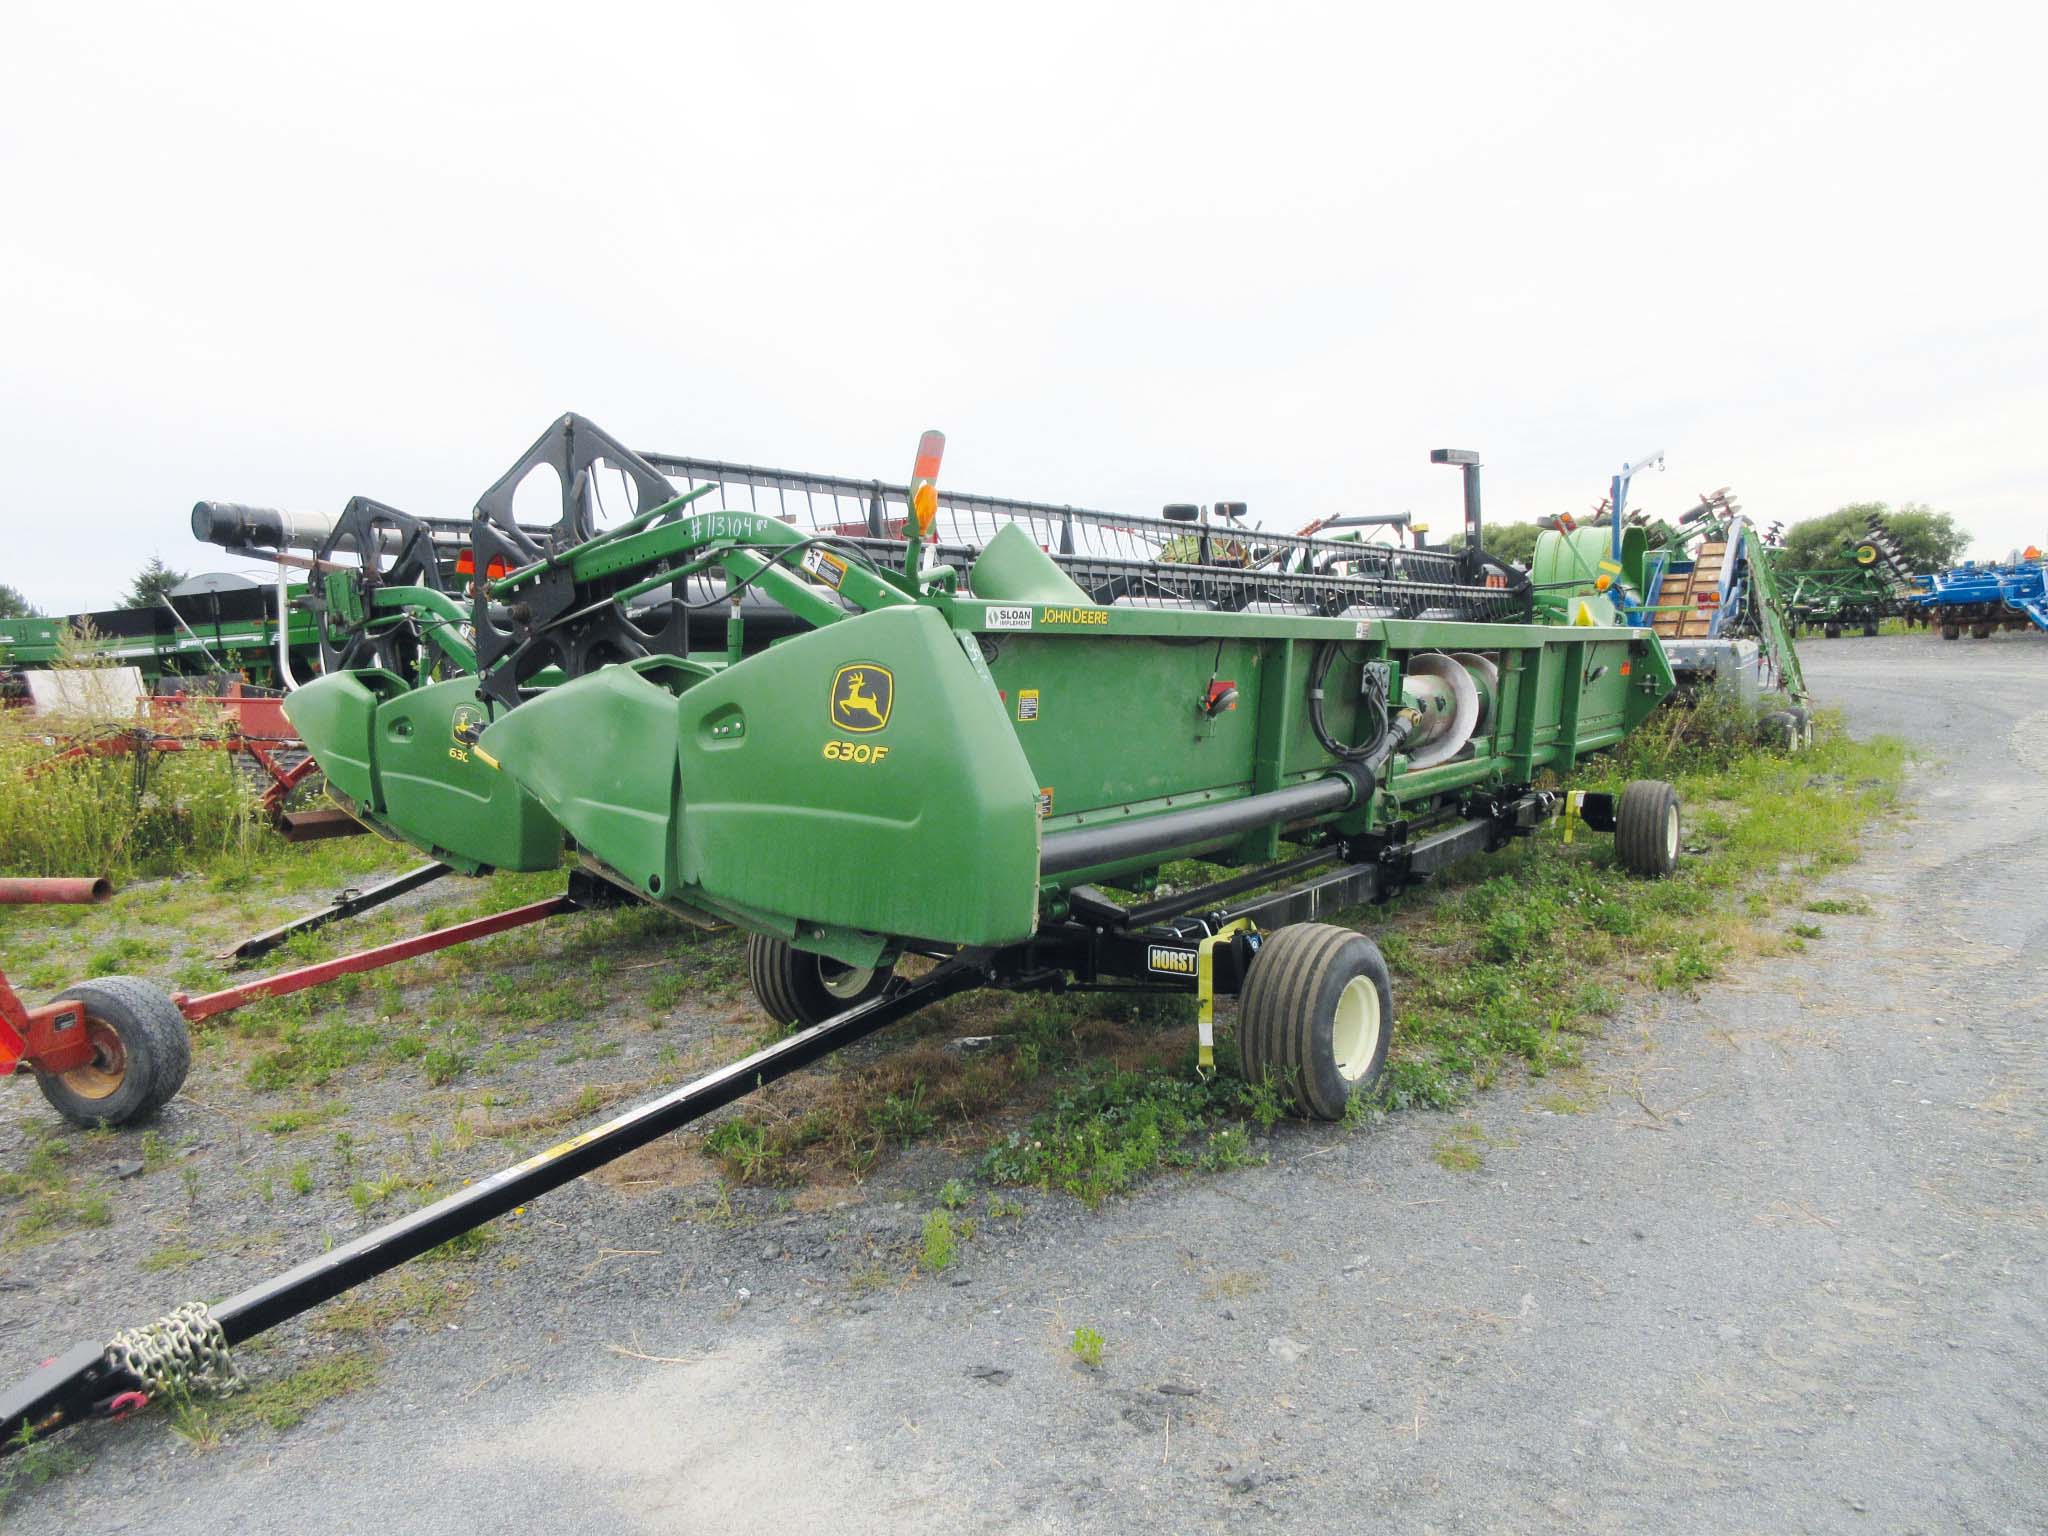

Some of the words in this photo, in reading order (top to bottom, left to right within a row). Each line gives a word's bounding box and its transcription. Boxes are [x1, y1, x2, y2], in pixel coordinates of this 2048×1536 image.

[1000, 610, 1031, 620] SLOAN
[1040, 607, 1072, 625] JOHN
[1072, 608, 1109, 625] DEERE
[823, 741, 889, 764] 630F
[1151, 949, 1196, 972] HORST
